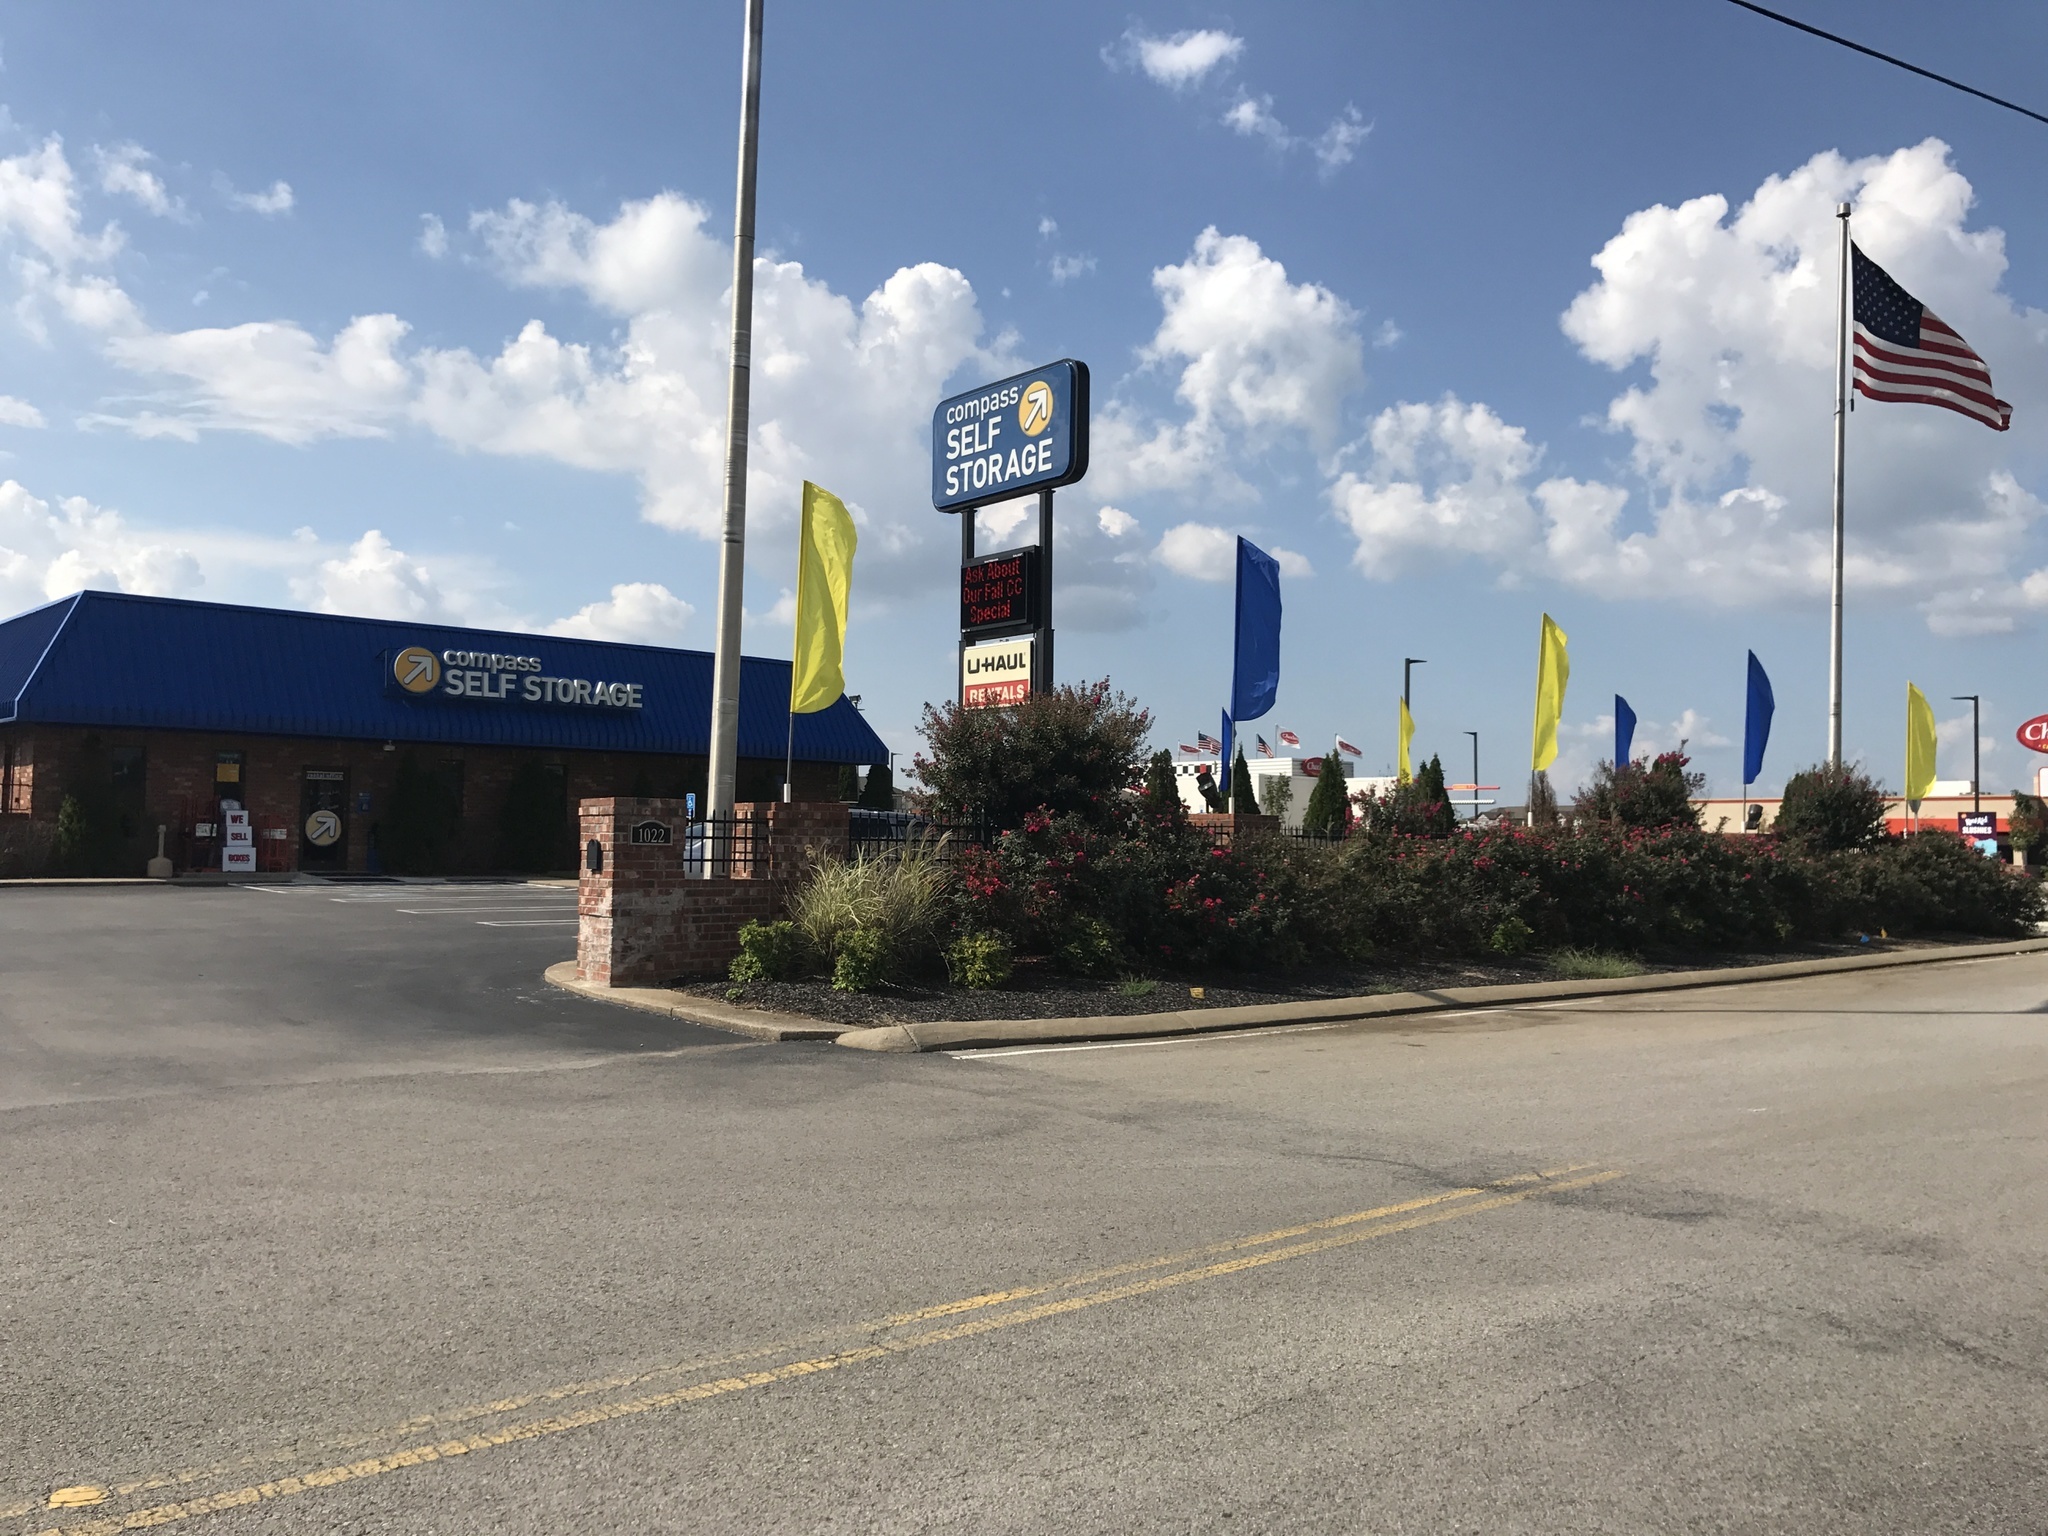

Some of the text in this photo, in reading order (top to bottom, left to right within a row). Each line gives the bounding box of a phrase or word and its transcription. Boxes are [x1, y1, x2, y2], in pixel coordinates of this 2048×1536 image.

[946, 386, 1019, 424] compass
[946, 415, 1002, 460] SELF
[945, 437, 1053, 496] STORAGE
[965, 558, 1020, 584] Ask About
[963, 577, 1022, 604] Our Fall CC
[970, 600, 1011, 624] Special
[443, 650, 542, 674] compass
[968, 652, 1026, 675] U-HAUL
[444, 669, 643, 709] SELF STORAGE
[230, 814, 244, 824] WE
[230, 832, 248, 841] SELL
[639, 828, 665, 843] 1022
[228, 853, 250, 862] BOXES
